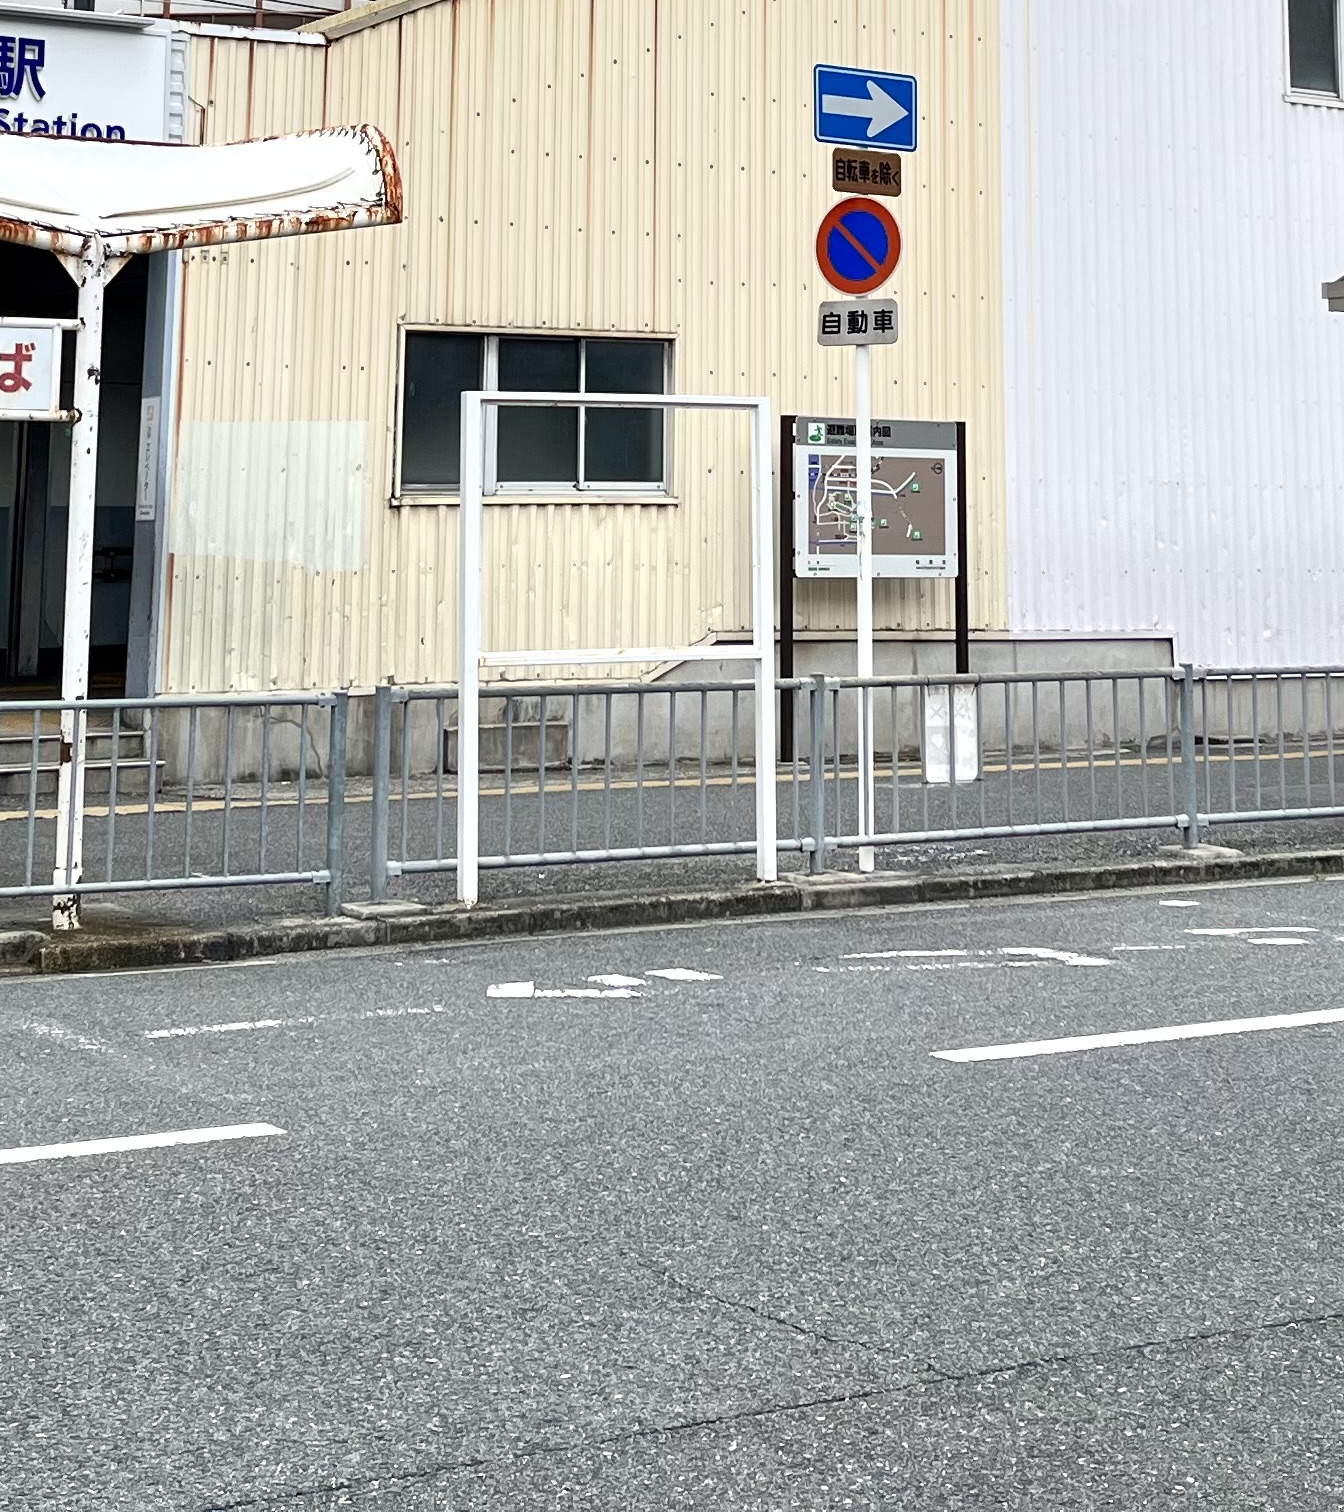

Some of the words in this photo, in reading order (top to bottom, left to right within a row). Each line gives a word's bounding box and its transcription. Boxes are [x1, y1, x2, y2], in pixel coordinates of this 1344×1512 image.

[835, 157, 901, 187] 自転車を除く
[821, 308, 894, 336] 自動車
